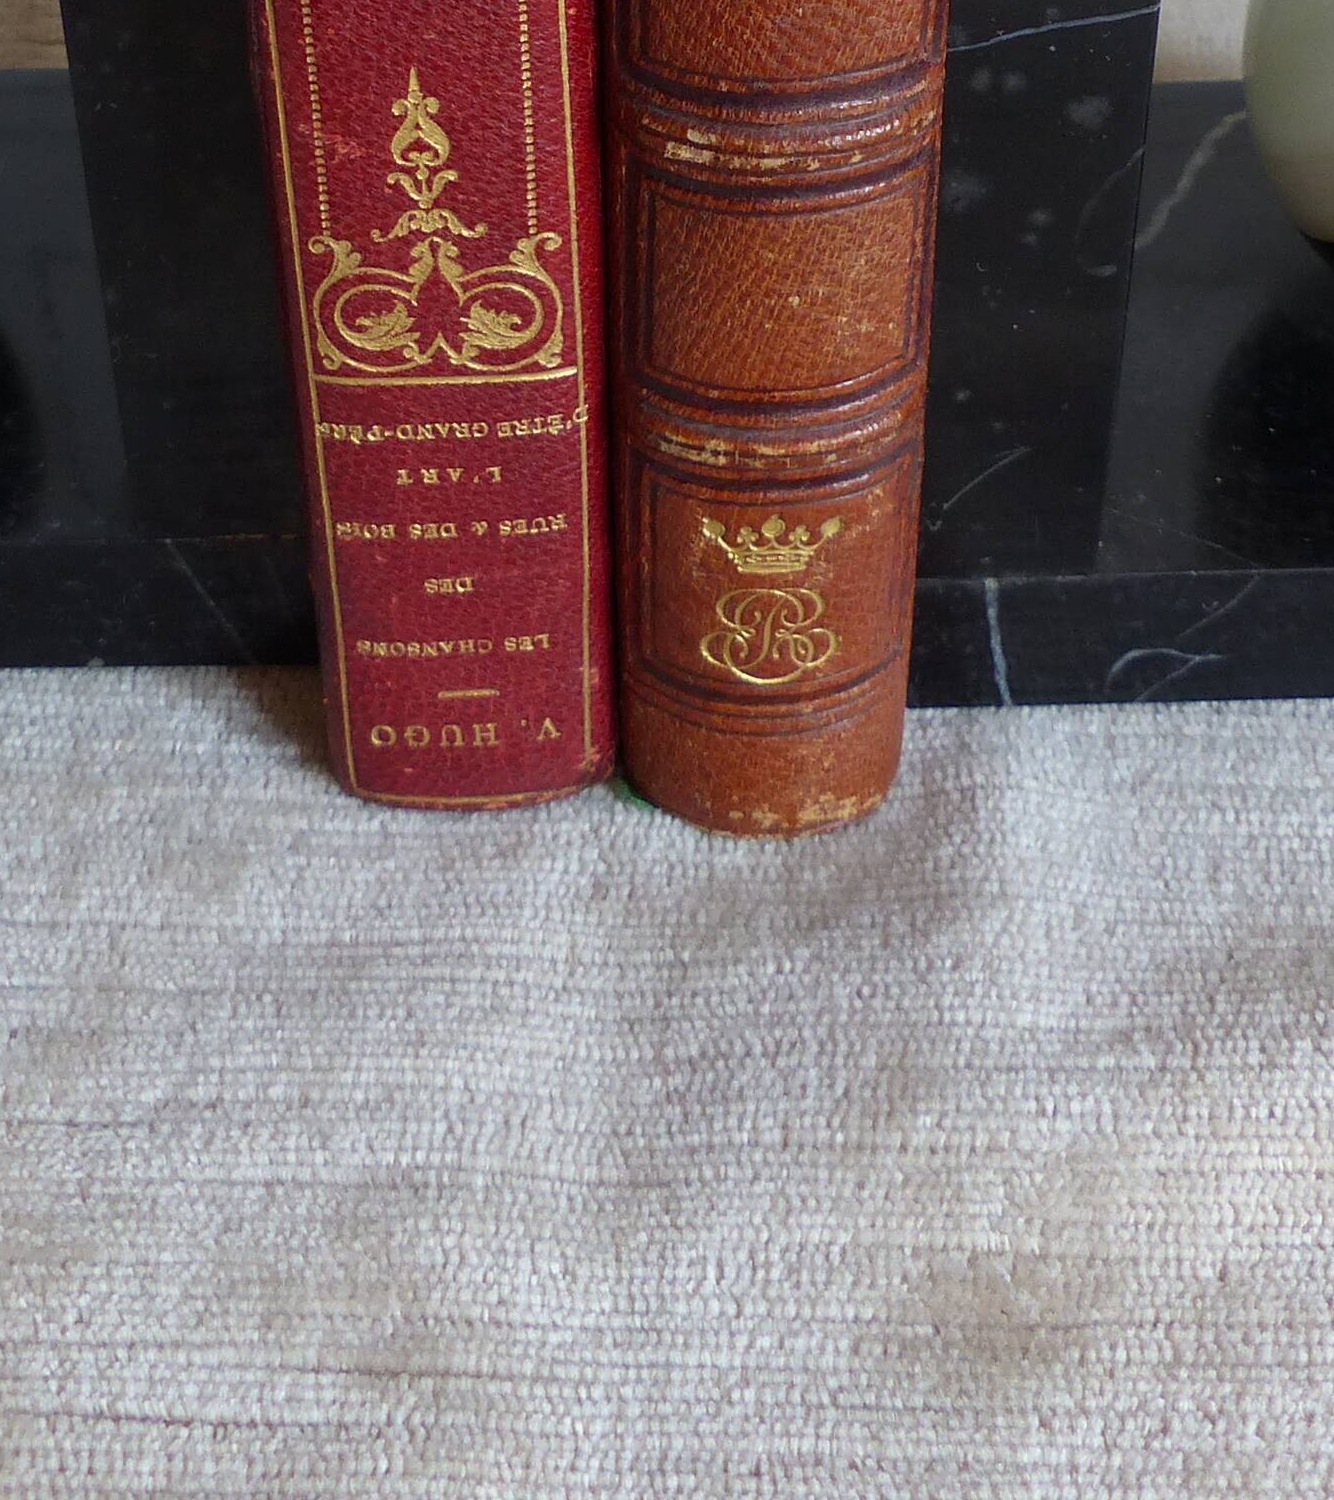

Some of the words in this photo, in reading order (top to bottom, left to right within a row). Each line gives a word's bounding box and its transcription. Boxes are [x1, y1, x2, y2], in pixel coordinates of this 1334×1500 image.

[395, 466, 502, 485] L'ART
[334, 521, 397, 540] BOIS
[407, 522, 459, 539] DES
[470, 520, 490, 536] &
[497, 513, 568, 536] RUES
[423, 576, 475, 594] DES
[355, 638, 493, 658] CHANSONS
[503, 633, 551, 651] LES
[369, 722, 500, 748] HUGO
[519, 716, 561, 741] V.
